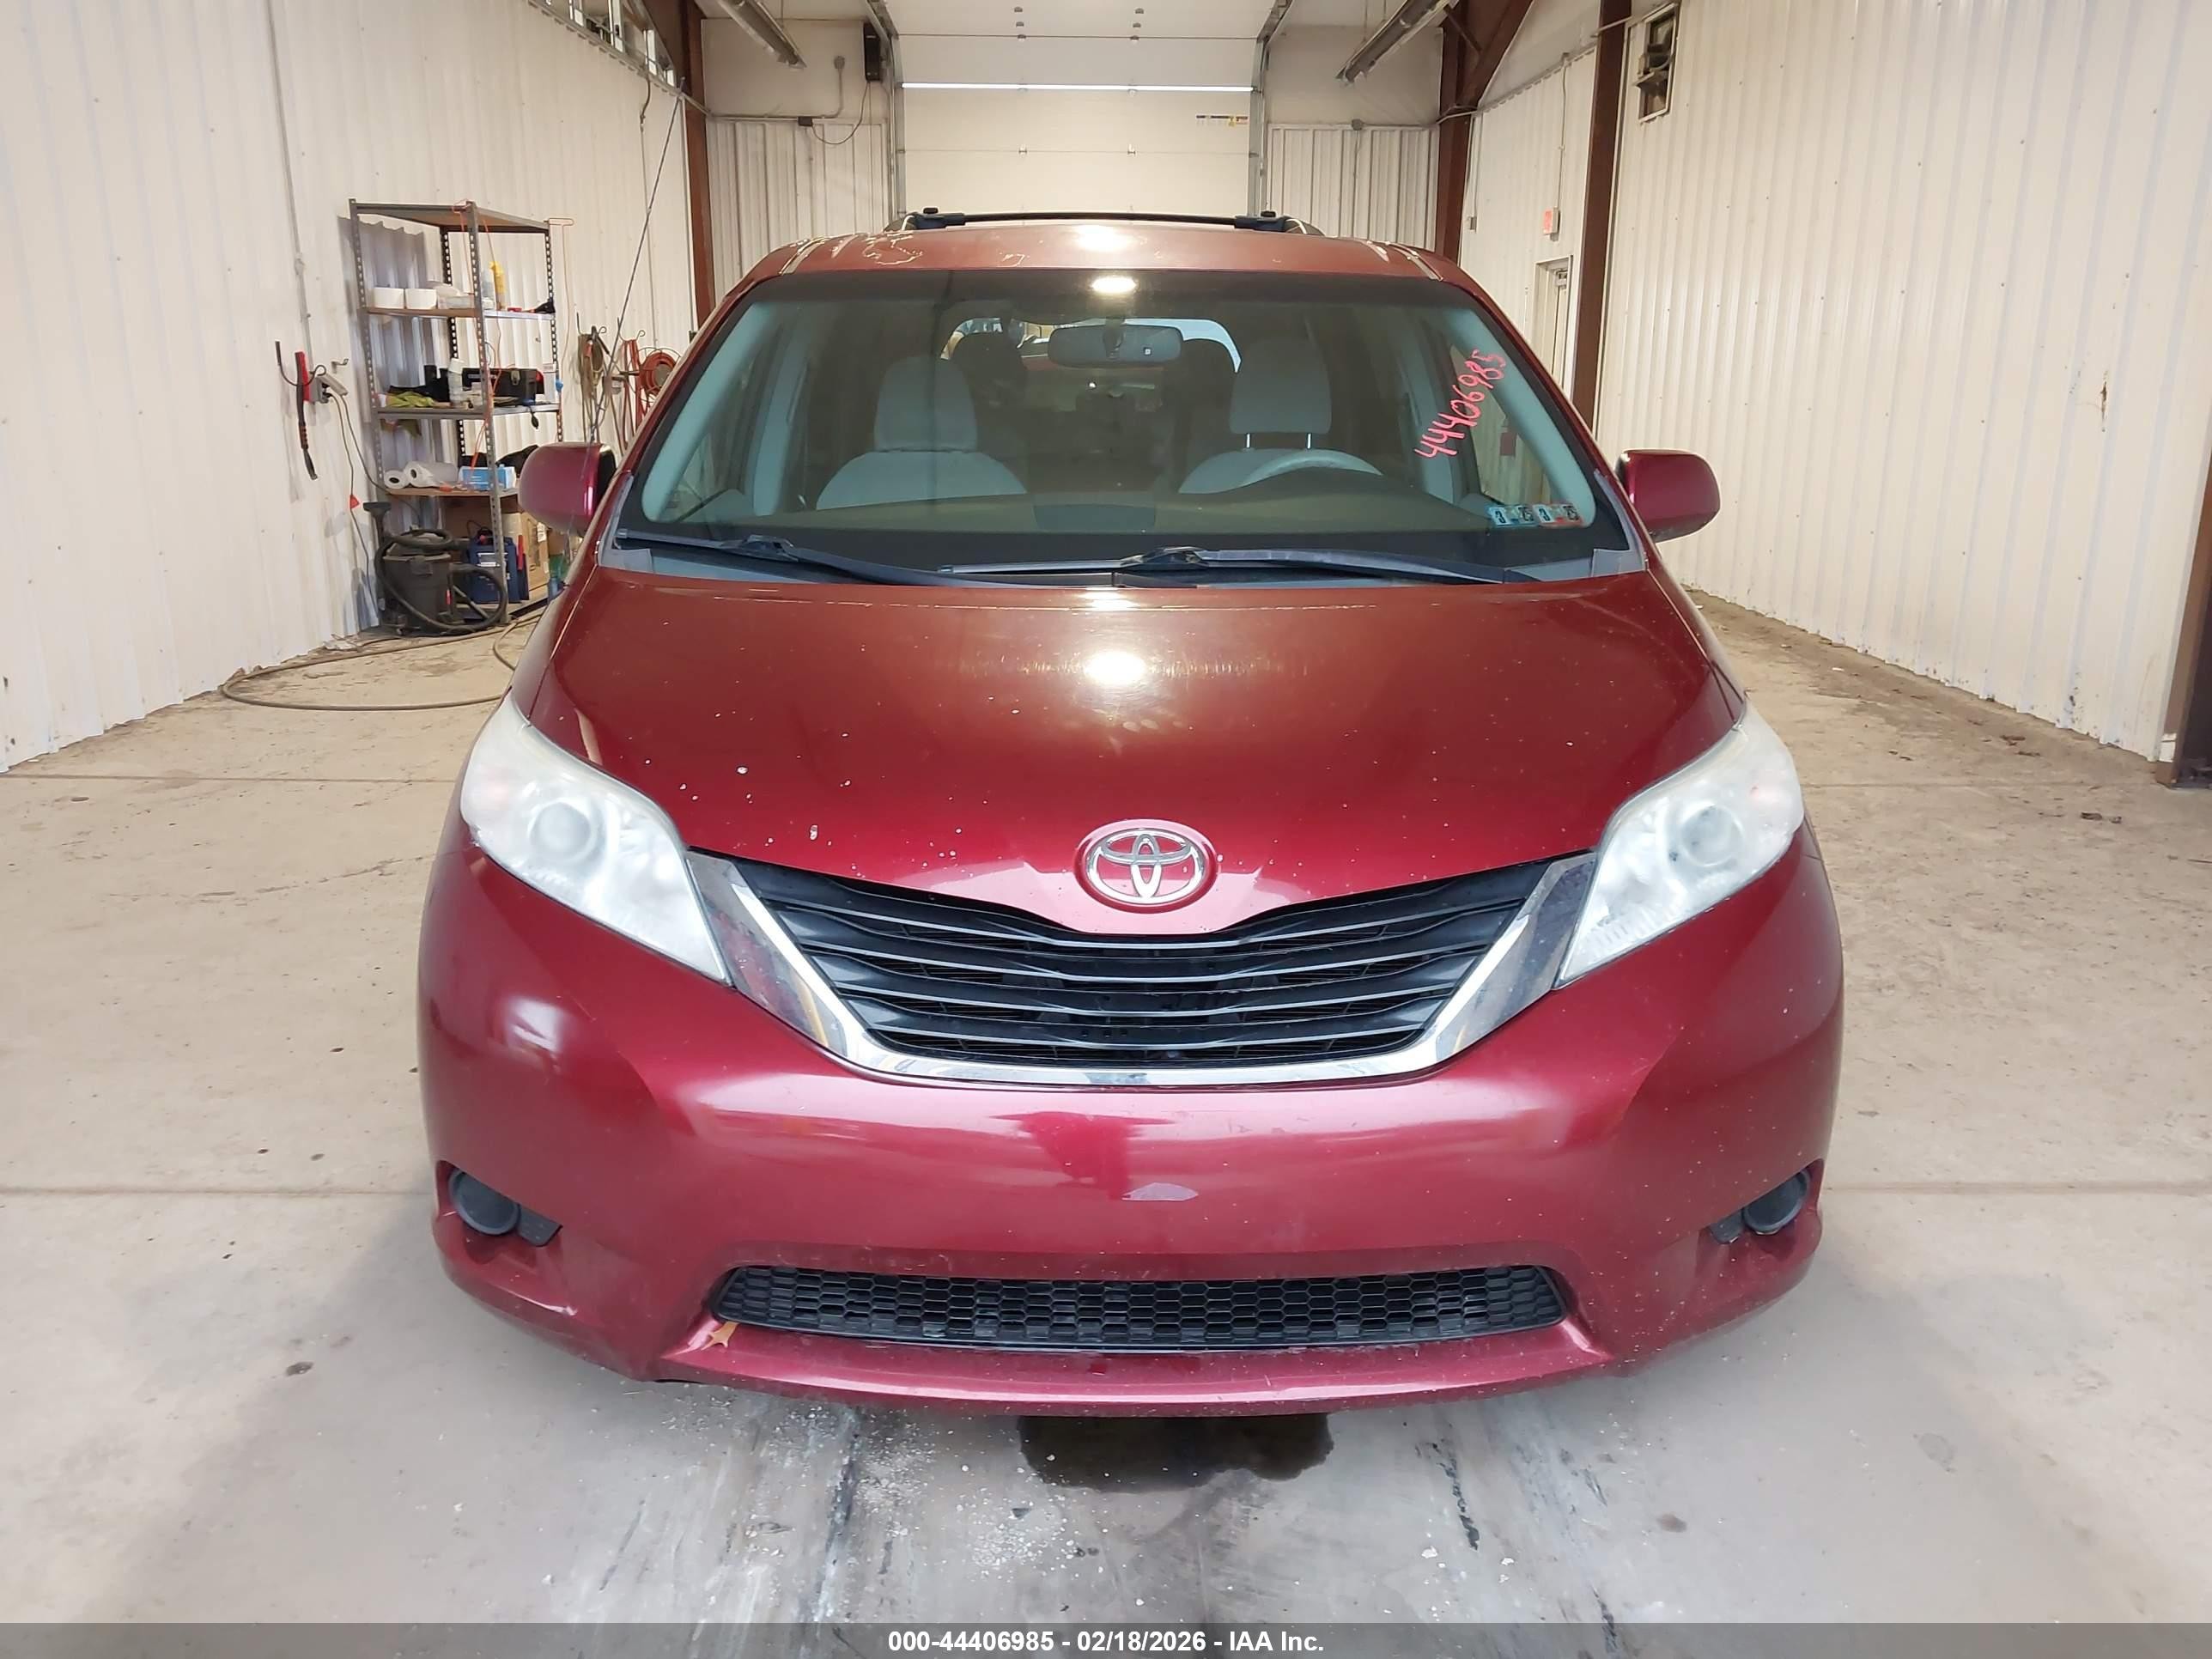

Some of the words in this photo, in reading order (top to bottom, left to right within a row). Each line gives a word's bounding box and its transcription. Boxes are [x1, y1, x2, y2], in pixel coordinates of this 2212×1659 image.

[1414, 349, 1505, 457] 44406985
[1495, 510, 1506, 524] 3
[1538, 507, 1551, 521] 3
